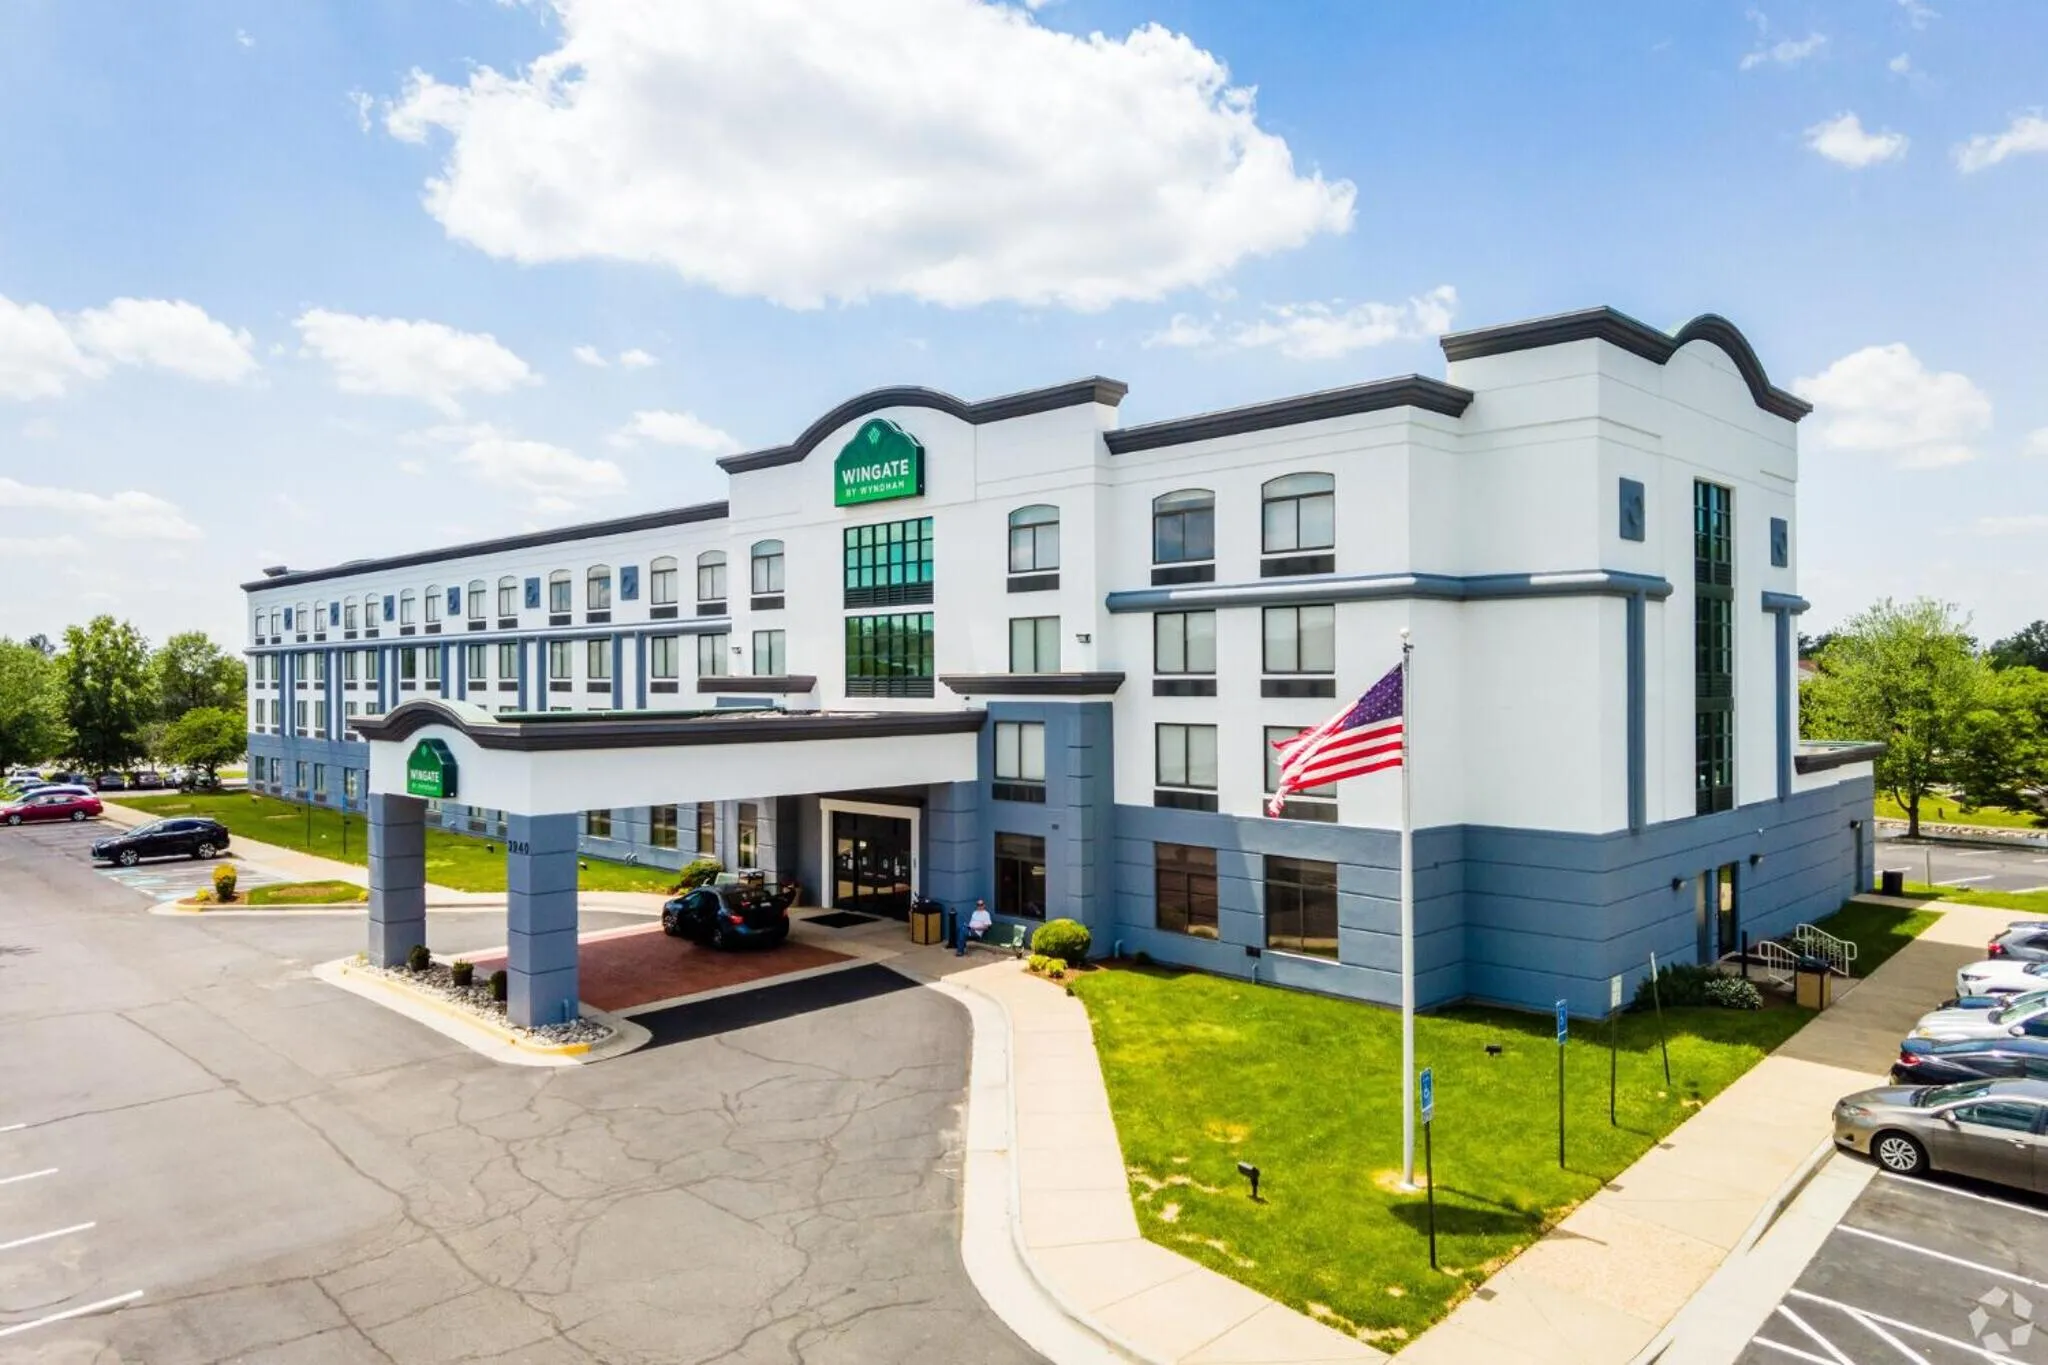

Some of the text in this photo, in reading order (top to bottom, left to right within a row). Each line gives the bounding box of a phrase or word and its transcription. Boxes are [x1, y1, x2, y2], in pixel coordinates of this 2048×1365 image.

[842, 459, 909, 485] WINGATE
[845, 480, 905, 498] BY WYNDHAM
[410, 769, 440, 783] WINGATE
